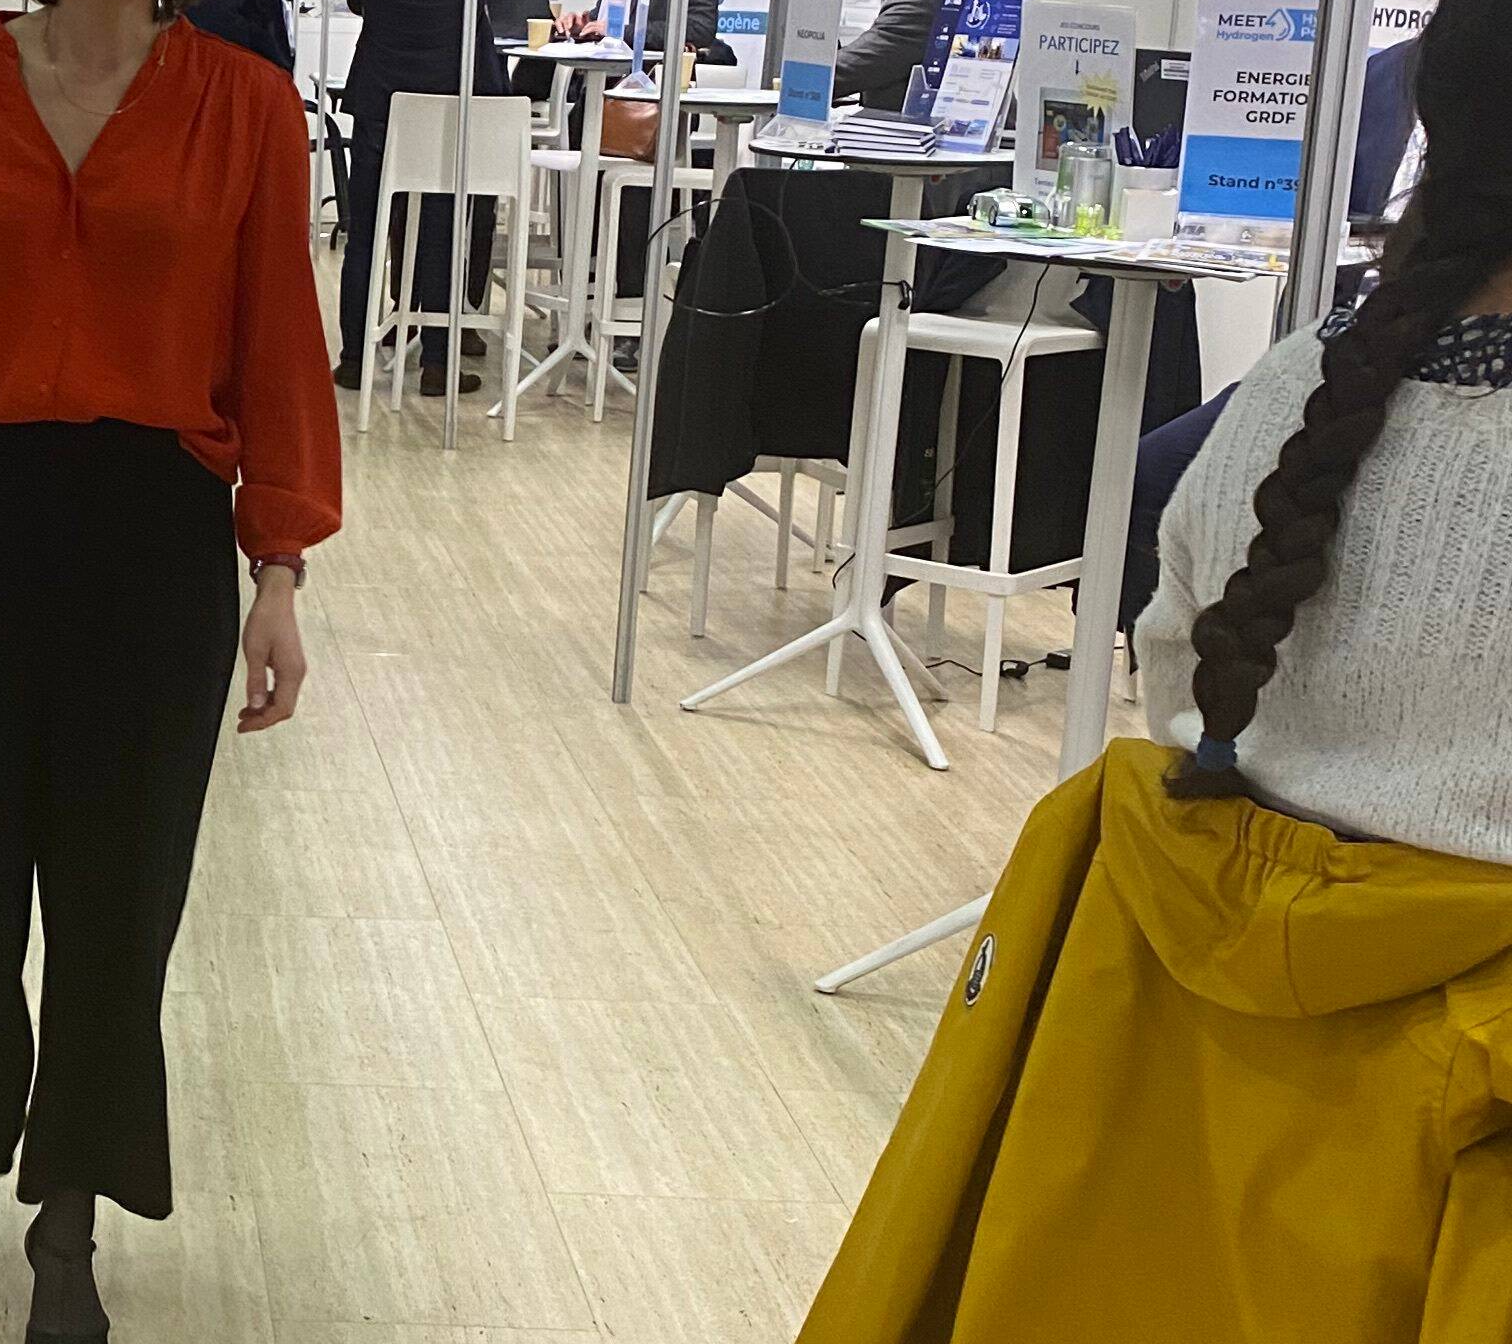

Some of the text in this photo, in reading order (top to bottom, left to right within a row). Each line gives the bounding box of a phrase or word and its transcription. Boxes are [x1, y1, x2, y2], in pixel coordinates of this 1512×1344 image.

[718, 13, 760, 32] ogène
[1373, 8, 1432, 29] HYDRO
[1216, 30, 1274, 42] Hydrogen
[1039, 35, 1120, 56] PARTICIPEZ
[1213, 90, 1307, 105] FORMATIO
[1246, 110, 1296, 124] GRDF
[1208, 174, 1259, 189] Stand
